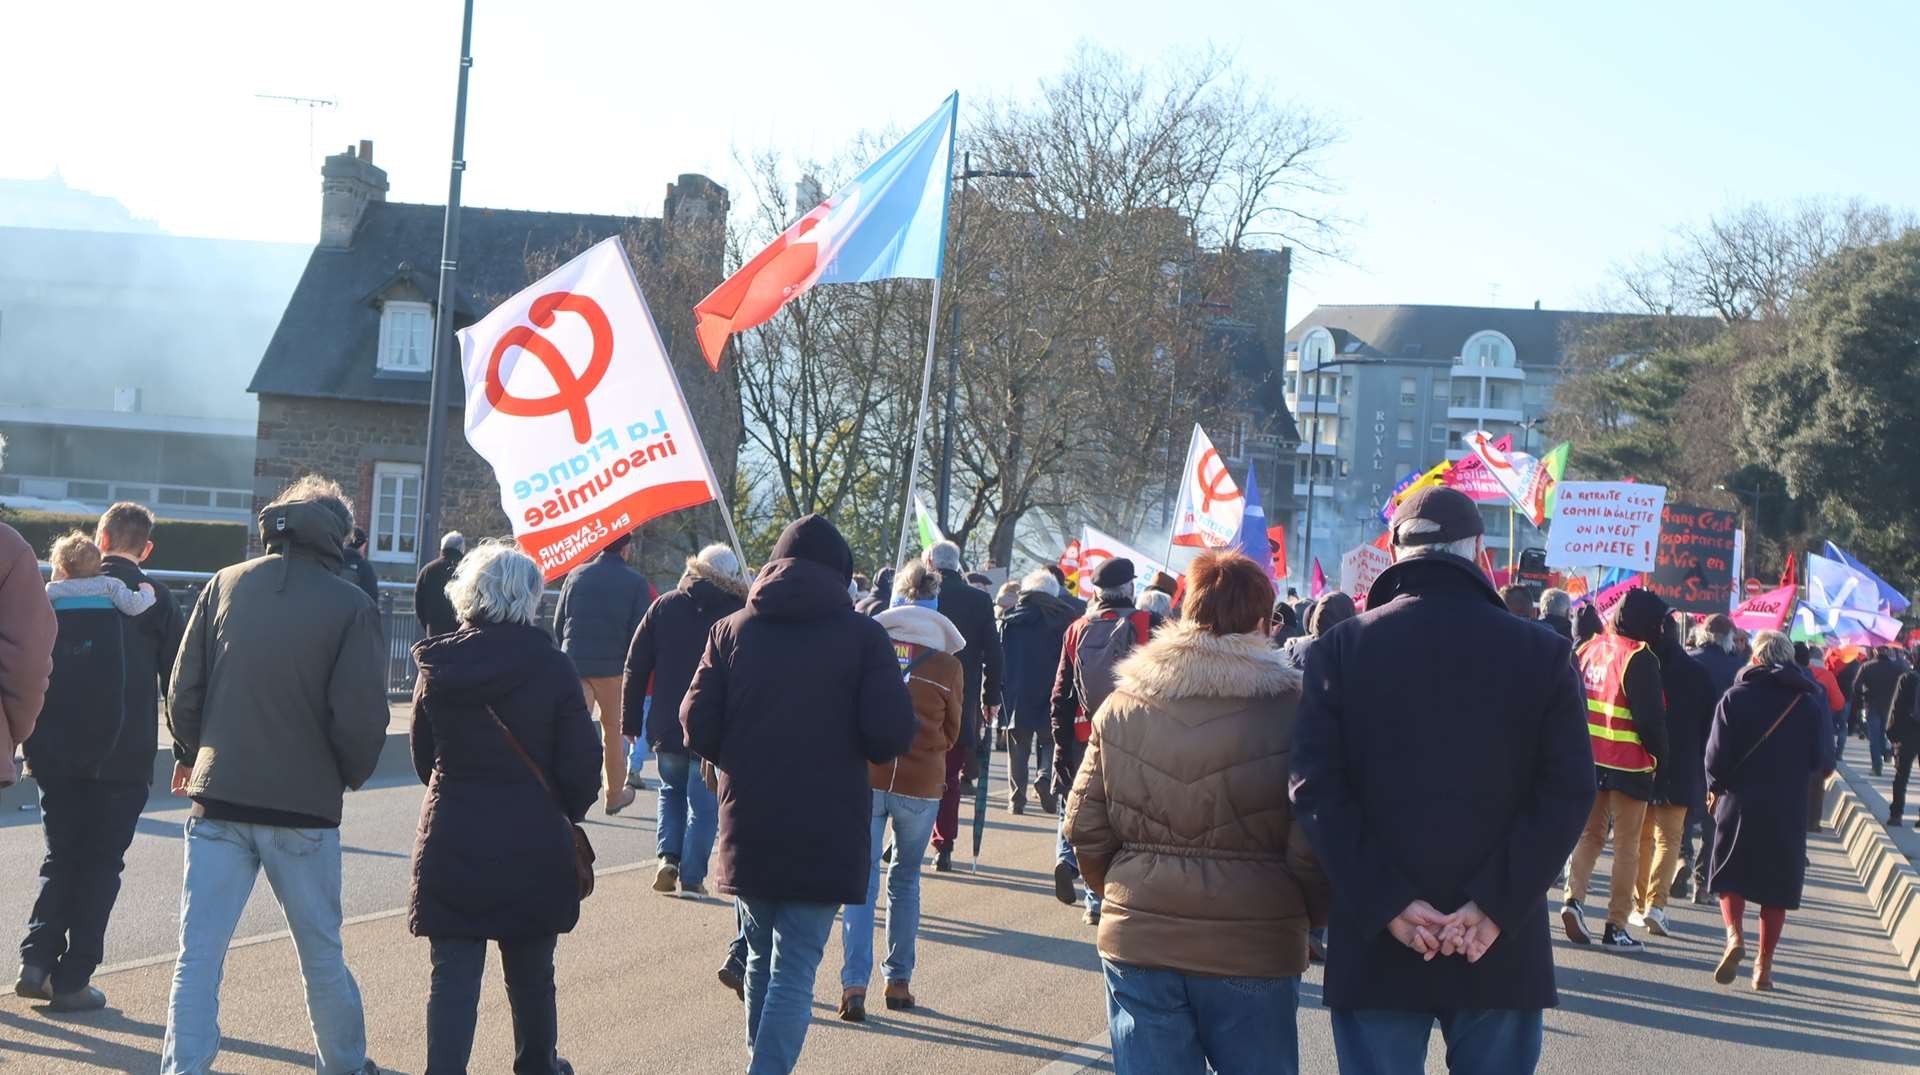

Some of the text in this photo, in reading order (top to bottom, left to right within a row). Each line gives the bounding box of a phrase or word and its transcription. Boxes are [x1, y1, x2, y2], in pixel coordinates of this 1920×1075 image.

[1373, 411, 1385, 470] ROYAL
[1560, 489, 1572, 500] LA
[1579, 489, 1620, 501] RETRAITE
[1576, 525, 1592, 535] ON
[1608, 524, 1641, 537] VEUT
[1705, 556, 1726, 571] en
